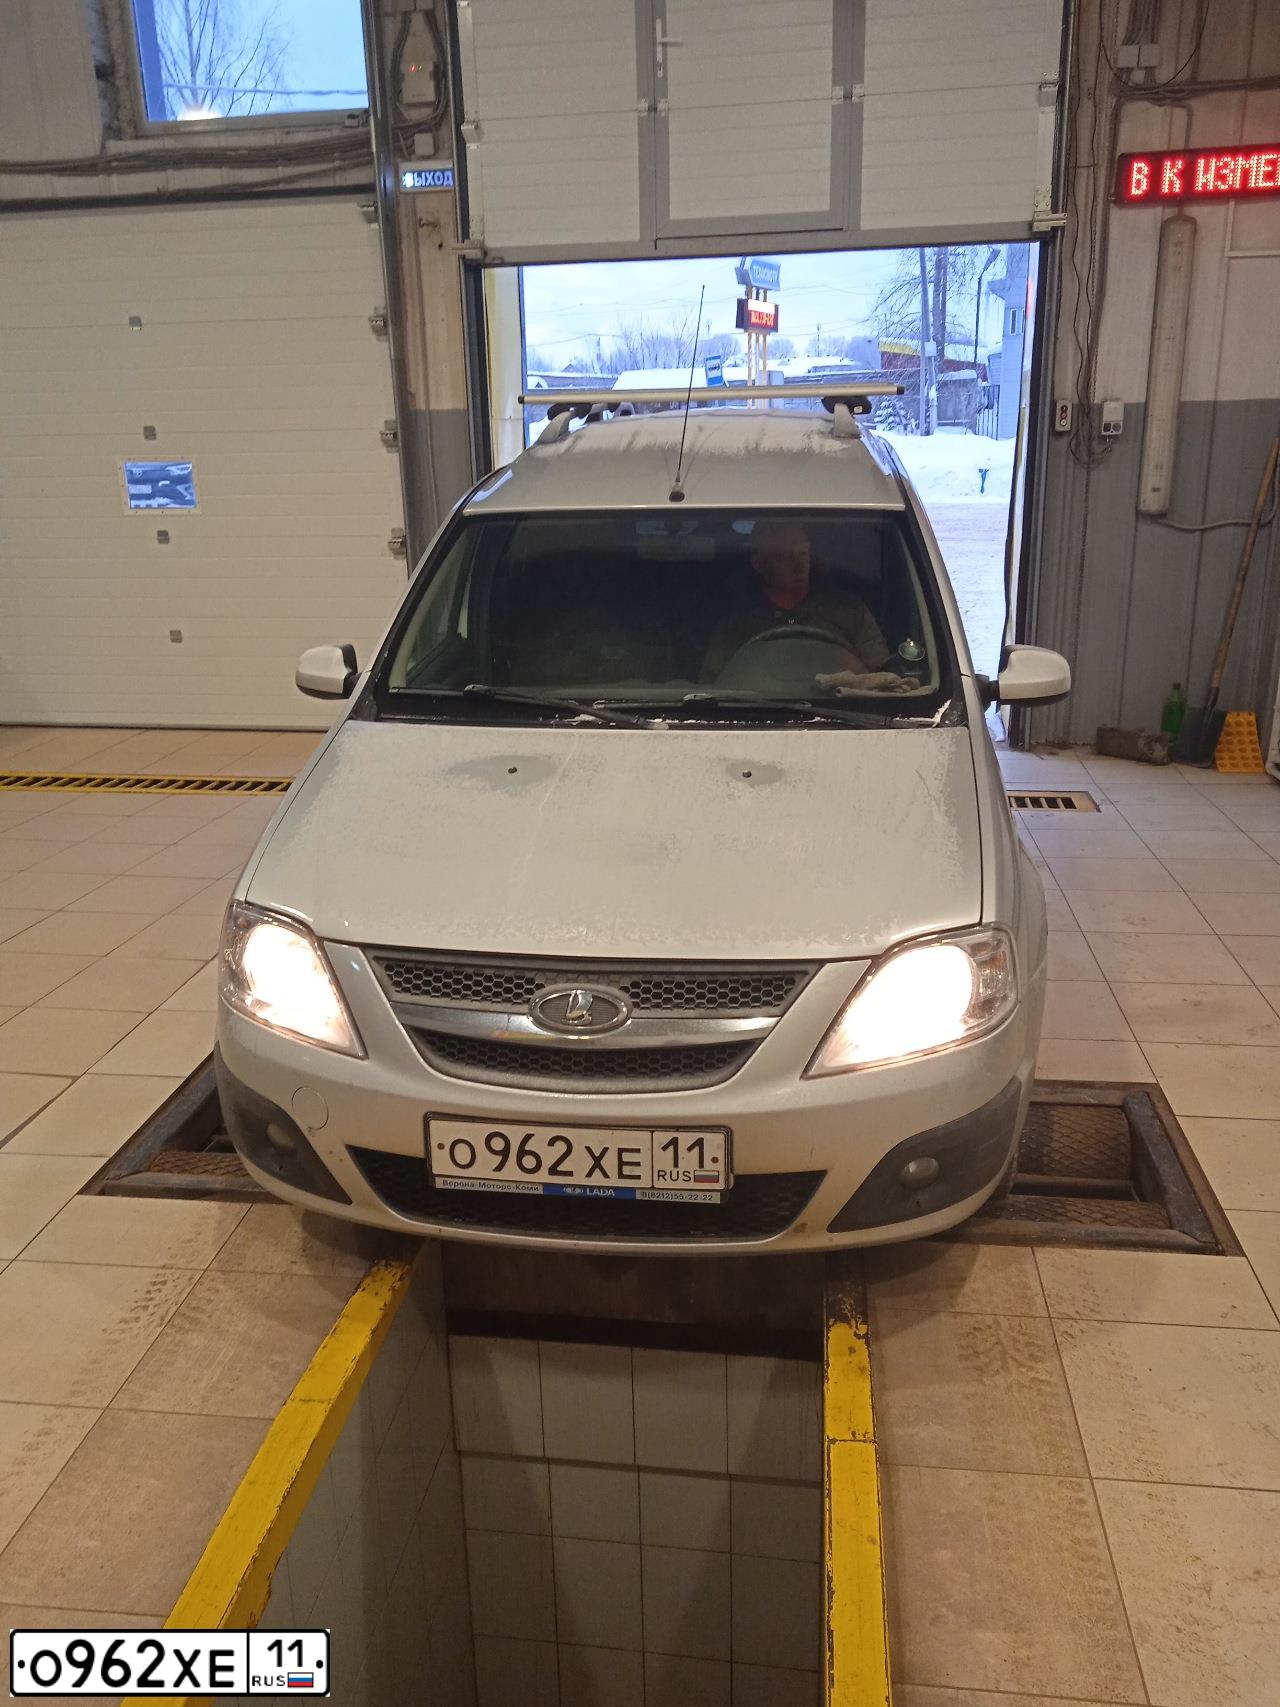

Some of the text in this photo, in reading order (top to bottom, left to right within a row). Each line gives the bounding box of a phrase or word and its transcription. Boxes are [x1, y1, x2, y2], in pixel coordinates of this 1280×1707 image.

[1131, 153, 1280, 196] В К ИЗМЕ
[661, 1136, 705, 1169] 11
[657, 1169, 692, 1183] RUS
[586, 1187, 615, 1197] LADA
